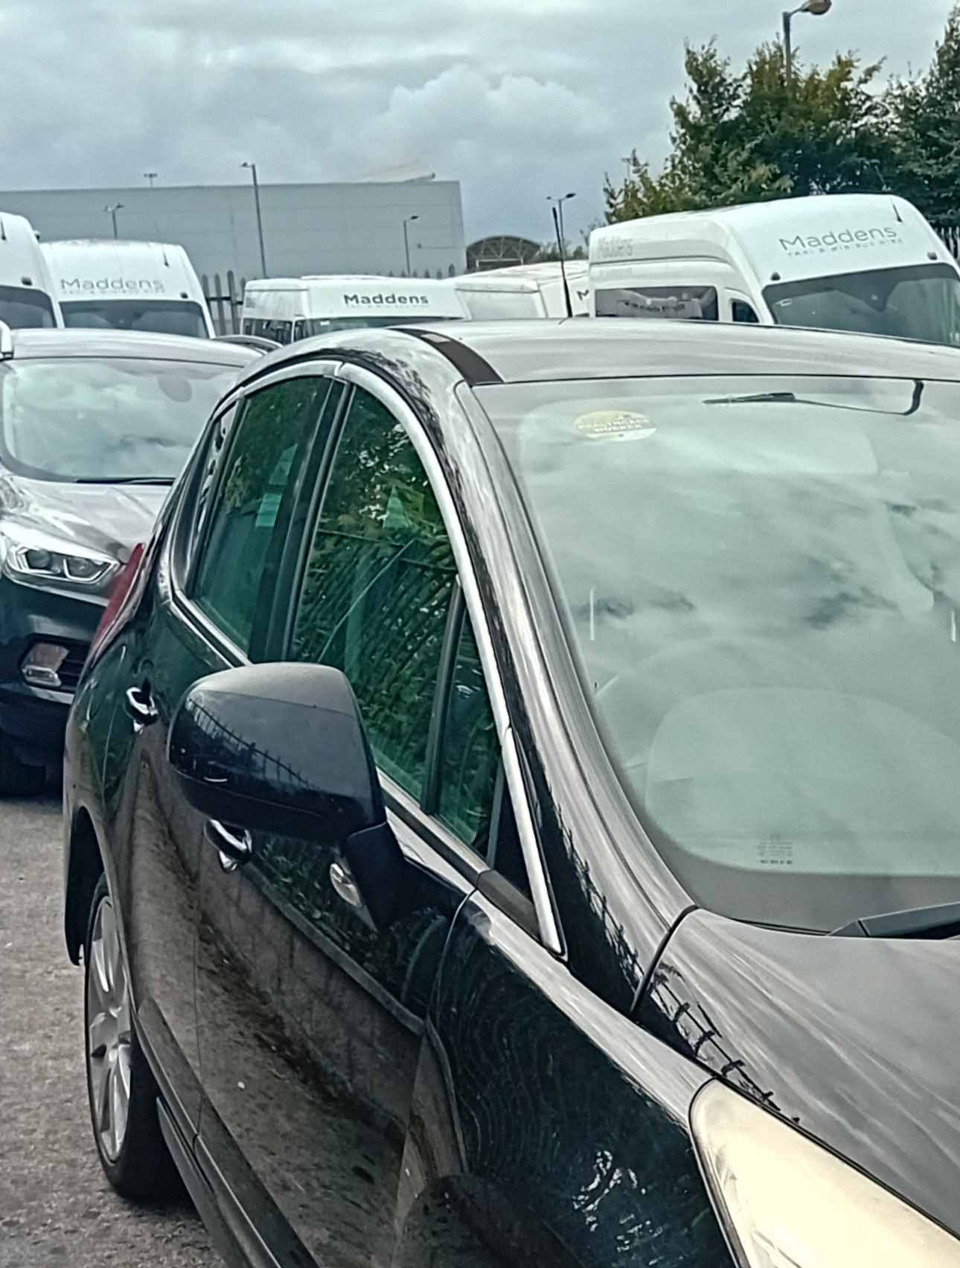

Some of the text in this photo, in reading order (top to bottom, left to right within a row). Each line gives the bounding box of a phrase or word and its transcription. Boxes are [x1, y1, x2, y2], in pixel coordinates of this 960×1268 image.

[779, 227, 898, 251] Maddens
[60, 277, 165, 291] Maddens
[343, 293, 429, 305] Maddens
